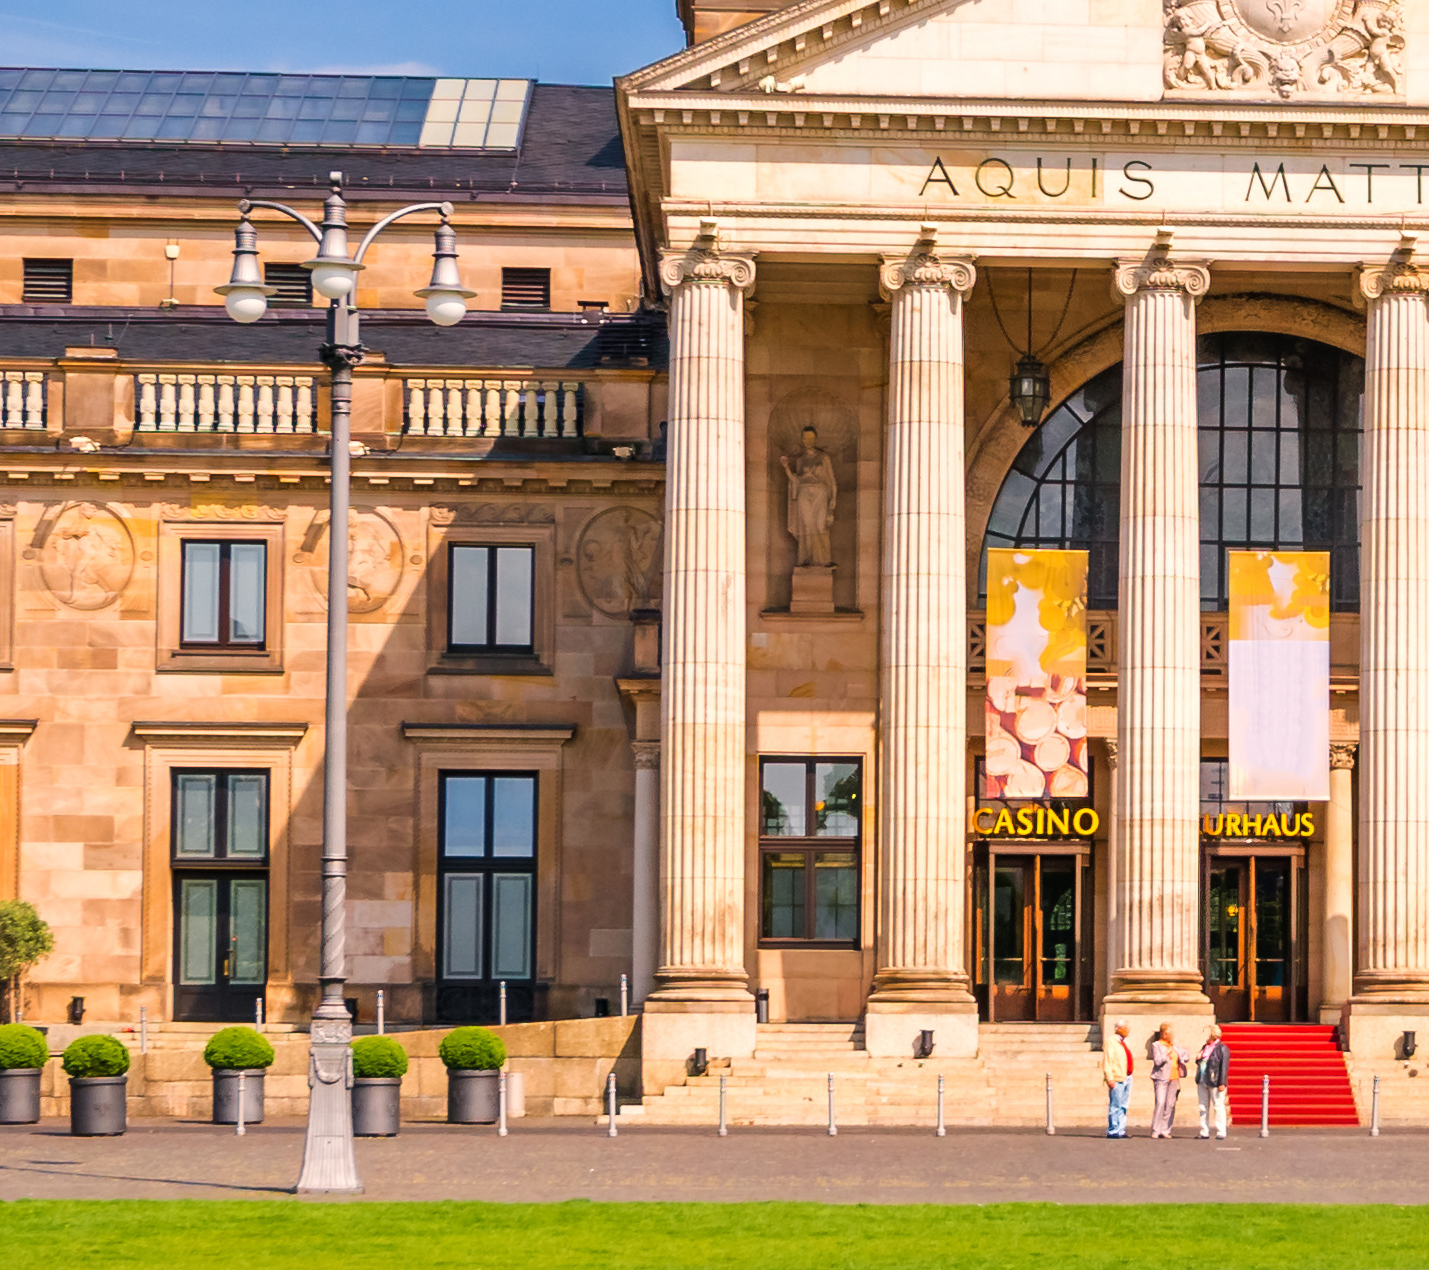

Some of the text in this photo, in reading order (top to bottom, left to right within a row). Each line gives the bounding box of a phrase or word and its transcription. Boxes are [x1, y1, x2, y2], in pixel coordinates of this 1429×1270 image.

[918, 156, 1154, 200] AQUIS
[972, 807, 1099, 835] CASINO
[1199, 812, 1315, 837] URHAUS
